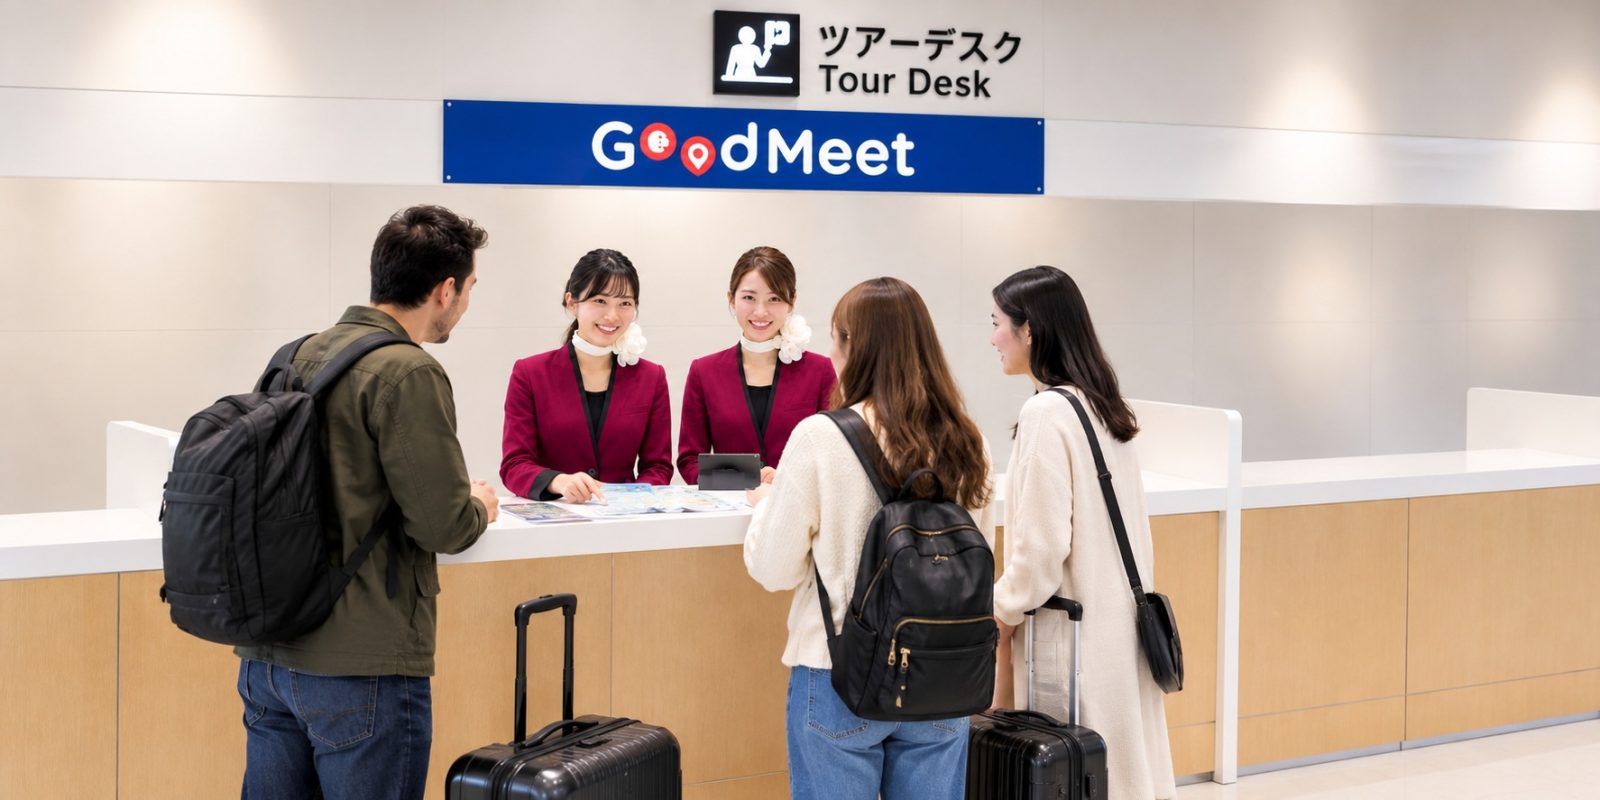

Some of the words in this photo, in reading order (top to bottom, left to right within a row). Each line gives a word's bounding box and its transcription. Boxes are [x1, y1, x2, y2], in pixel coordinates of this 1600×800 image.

[819, 25, 1022, 65] ツアーデスク
[819, 65, 896, 96] Tour
[908, 68, 991, 99] Desk
